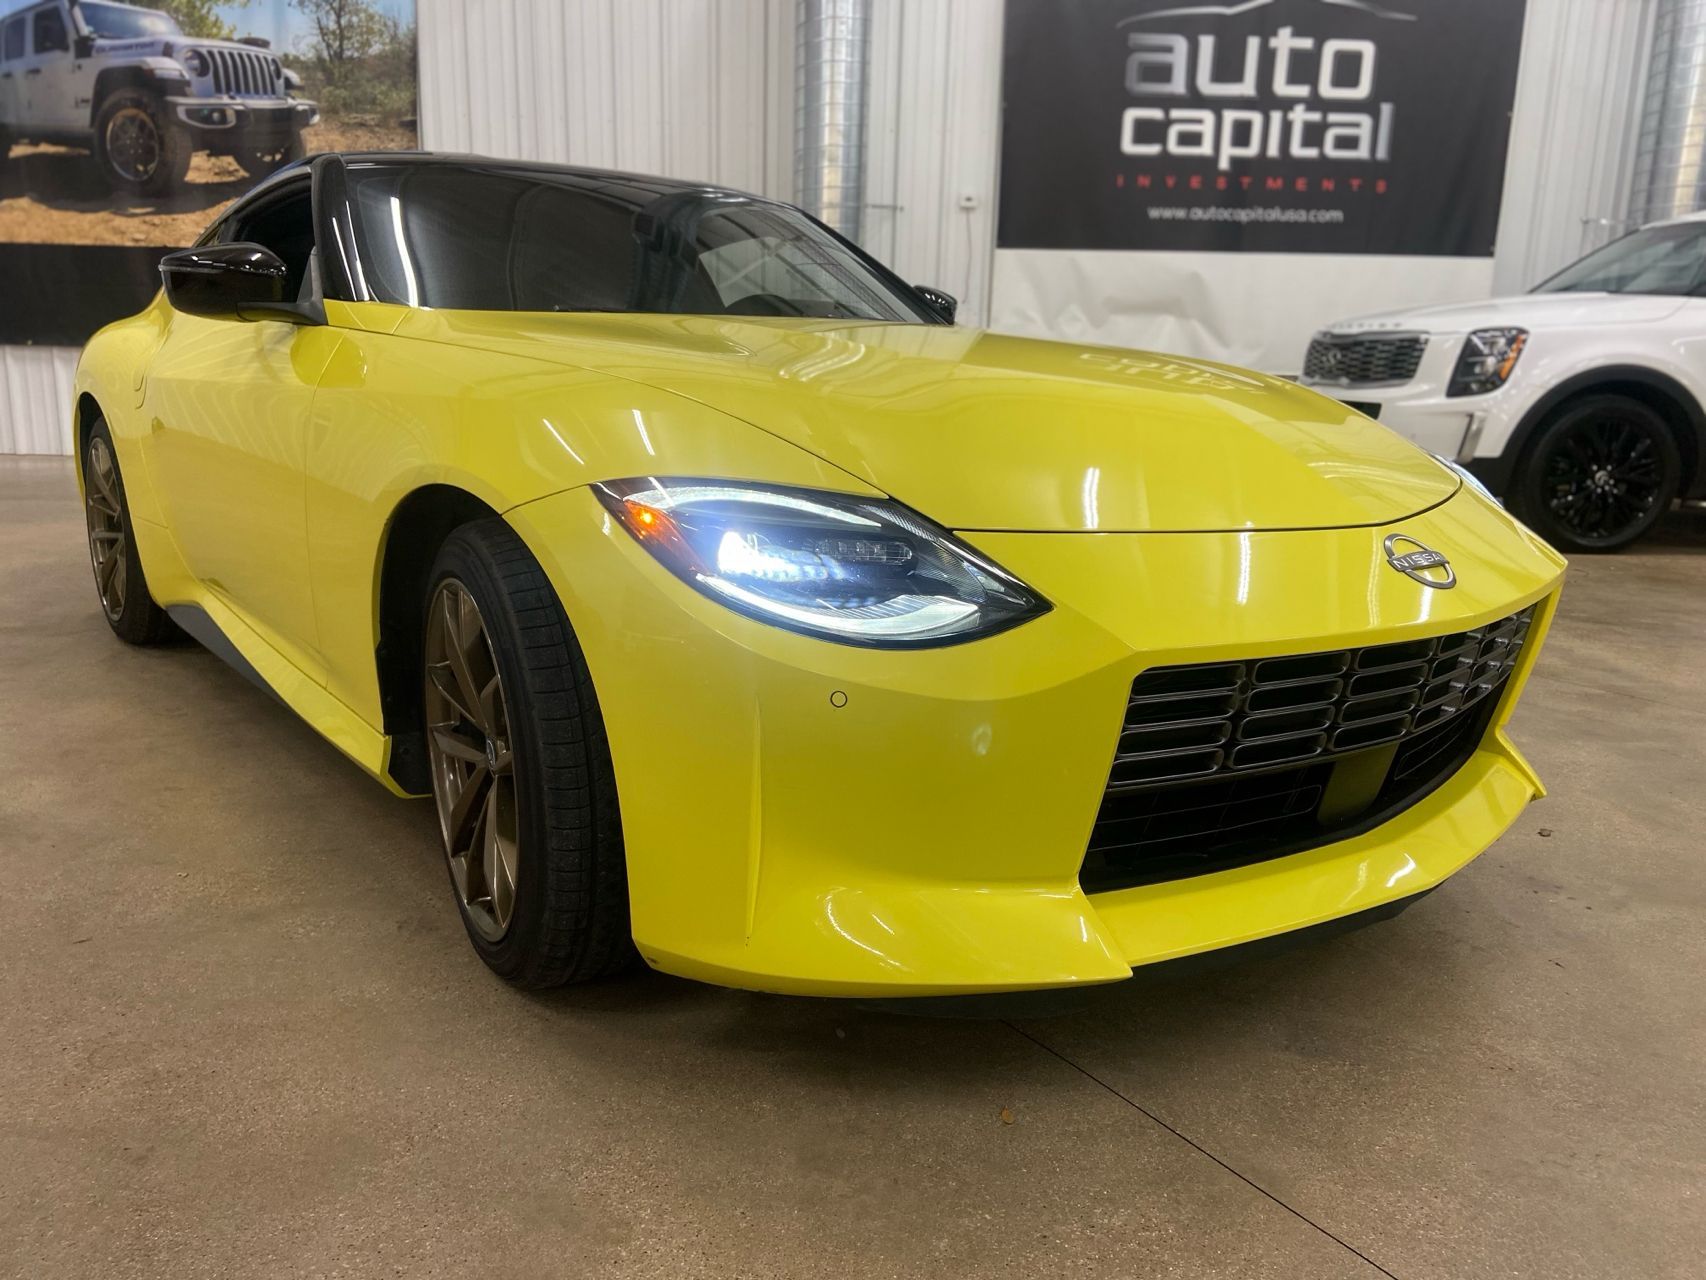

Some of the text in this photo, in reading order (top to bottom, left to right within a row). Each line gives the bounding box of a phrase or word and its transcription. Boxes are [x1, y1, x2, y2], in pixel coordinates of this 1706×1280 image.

[1125, 26, 1376, 99] auto
[1120, 102, 1394, 171] capital
[1116, 175, 1387, 194] INVESTMENTS
[1147, 206, 1344, 224] www.autocapitalusa.com
